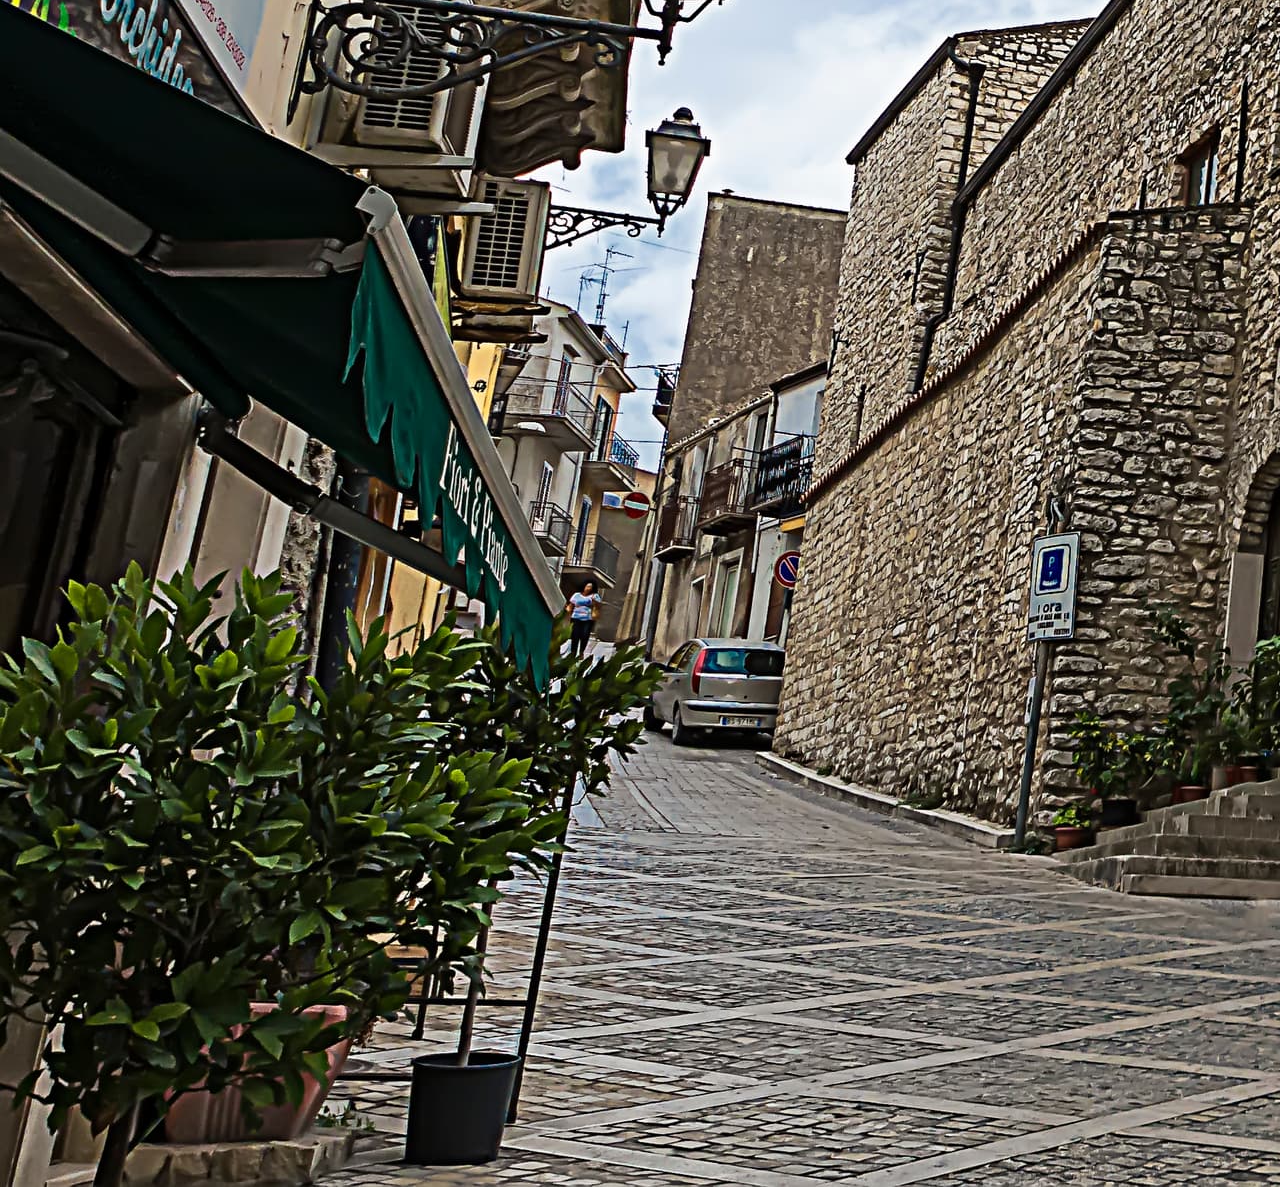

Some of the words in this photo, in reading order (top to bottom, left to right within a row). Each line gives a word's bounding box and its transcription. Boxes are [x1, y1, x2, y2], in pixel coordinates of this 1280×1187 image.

[439, 419, 473, 526] Fiori
[470, 476, 482, 539] &
[479, 491, 509, 592] Piante
[1042, 603, 1062, 613] ora
